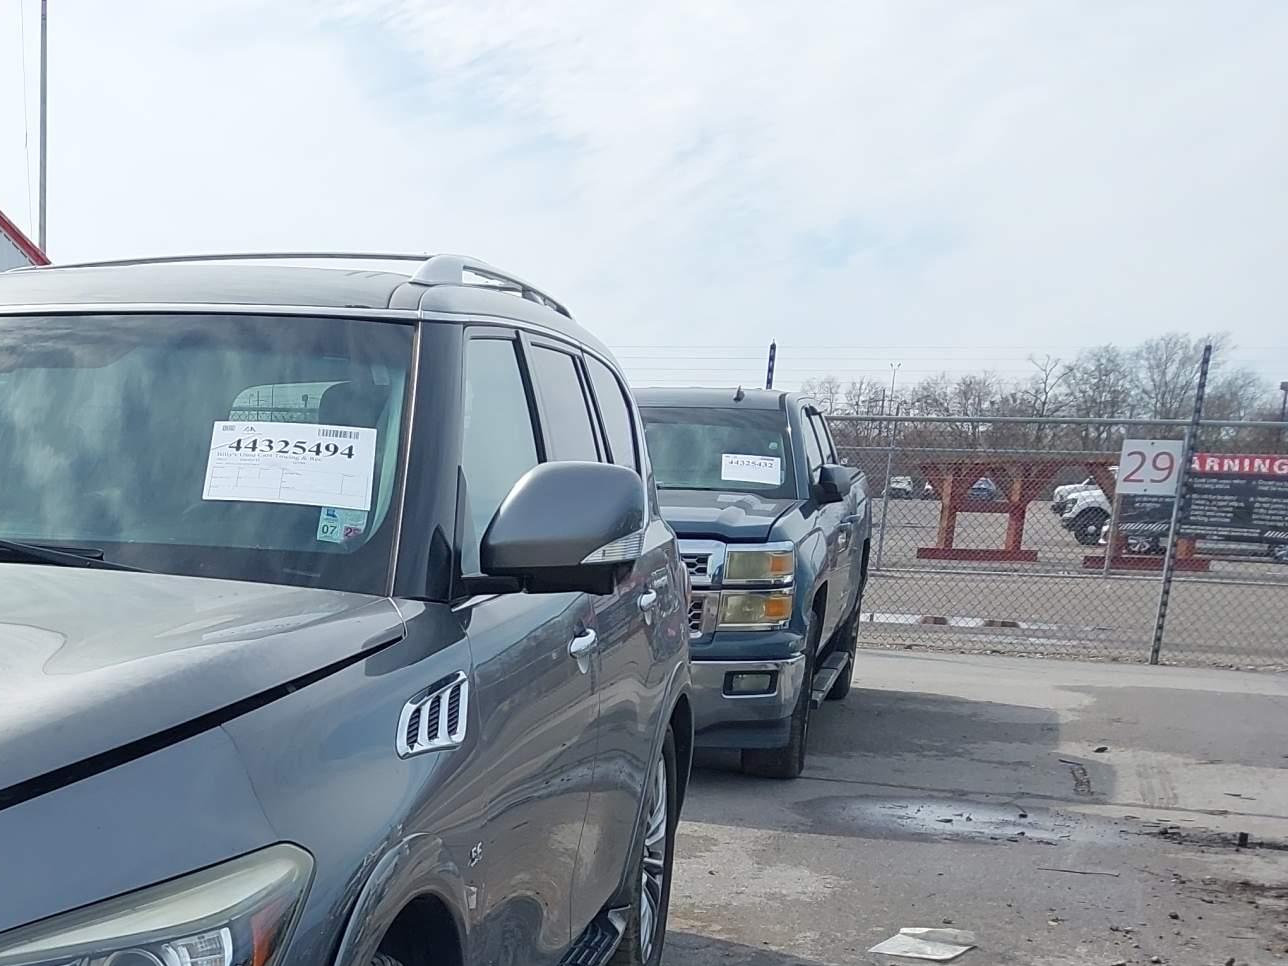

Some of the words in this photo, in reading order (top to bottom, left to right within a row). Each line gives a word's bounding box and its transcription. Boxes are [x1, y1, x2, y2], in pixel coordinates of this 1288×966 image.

[228, 438, 355, 459] 44325494
[1122, 450, 1175, 484] 29
[1191, 456, 1288, 474] ARNING
[322, 524, 337, 535] 07
